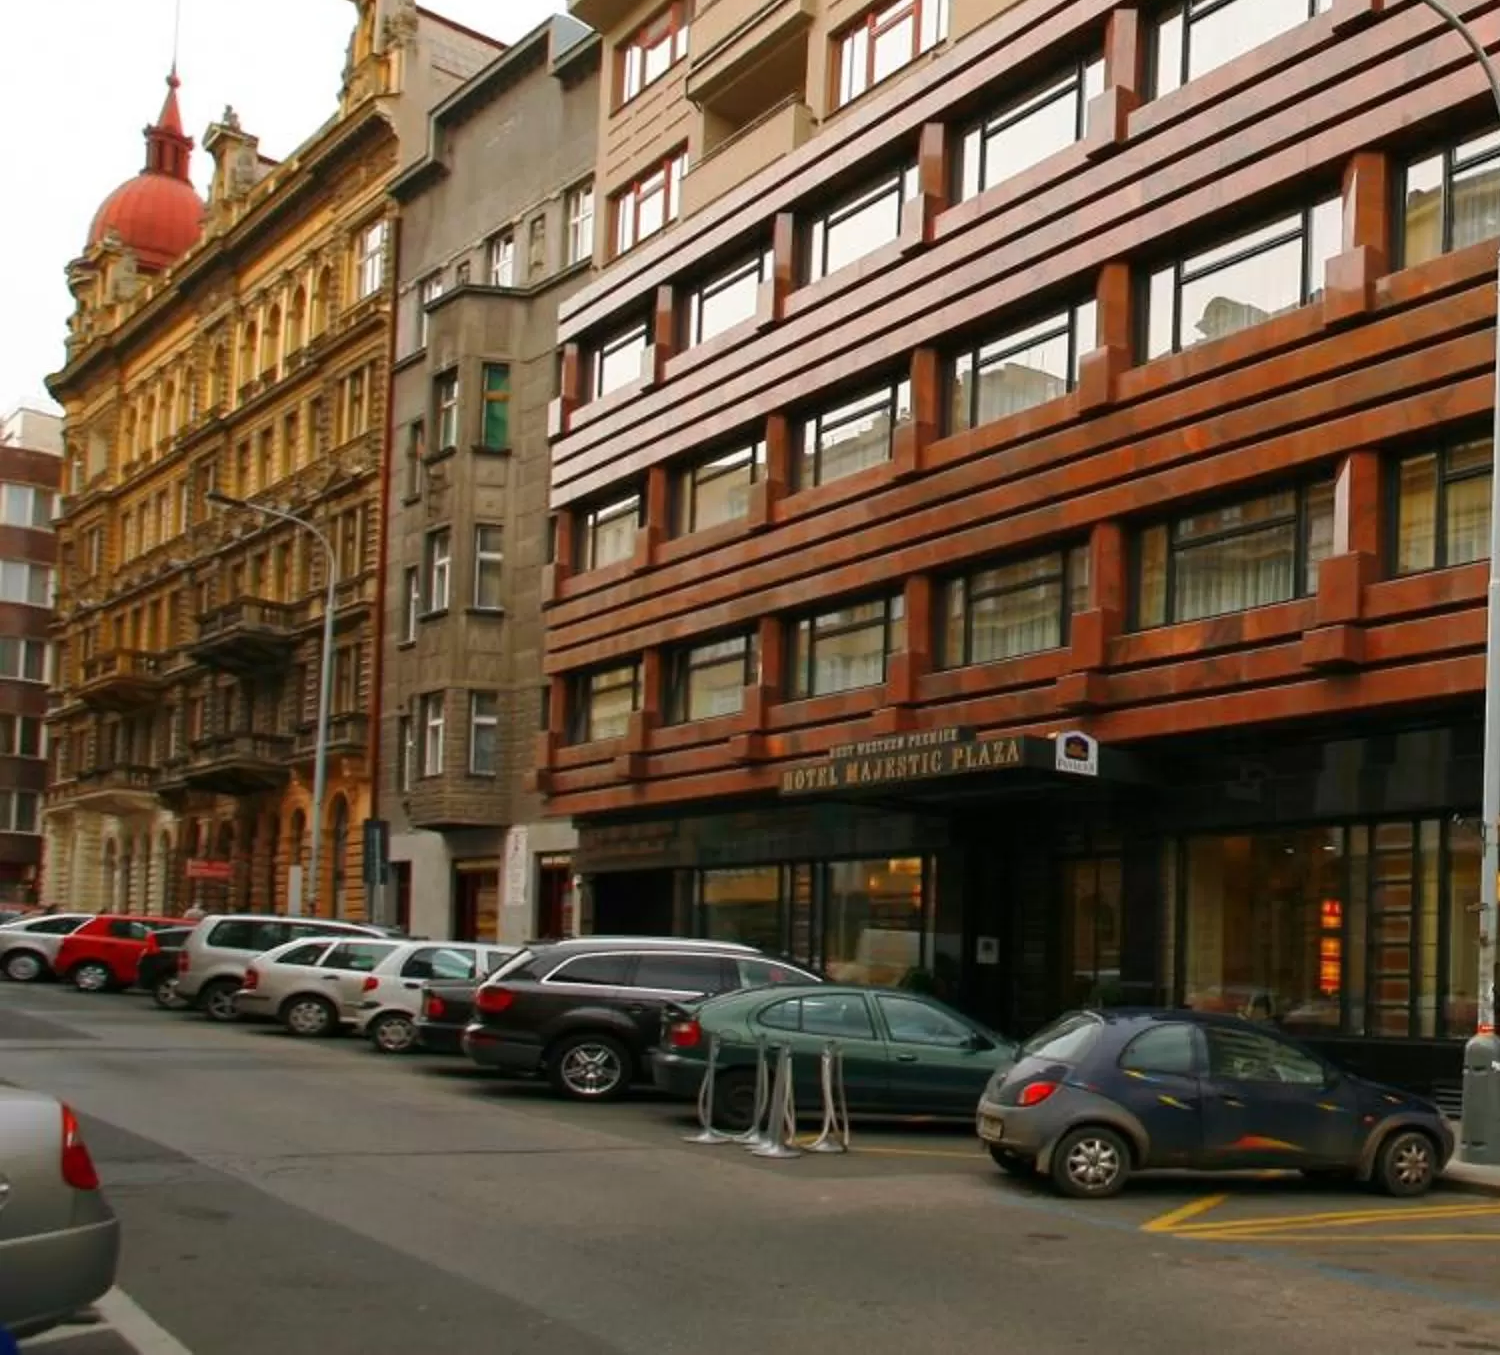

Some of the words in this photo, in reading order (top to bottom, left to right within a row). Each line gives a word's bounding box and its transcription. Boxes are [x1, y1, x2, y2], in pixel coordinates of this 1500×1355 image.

[783, 766, 838, 791] HOTEL
[845, 749, 943, 785] MAJESTIC
[951, 739, 1020, 771] PLAZA
